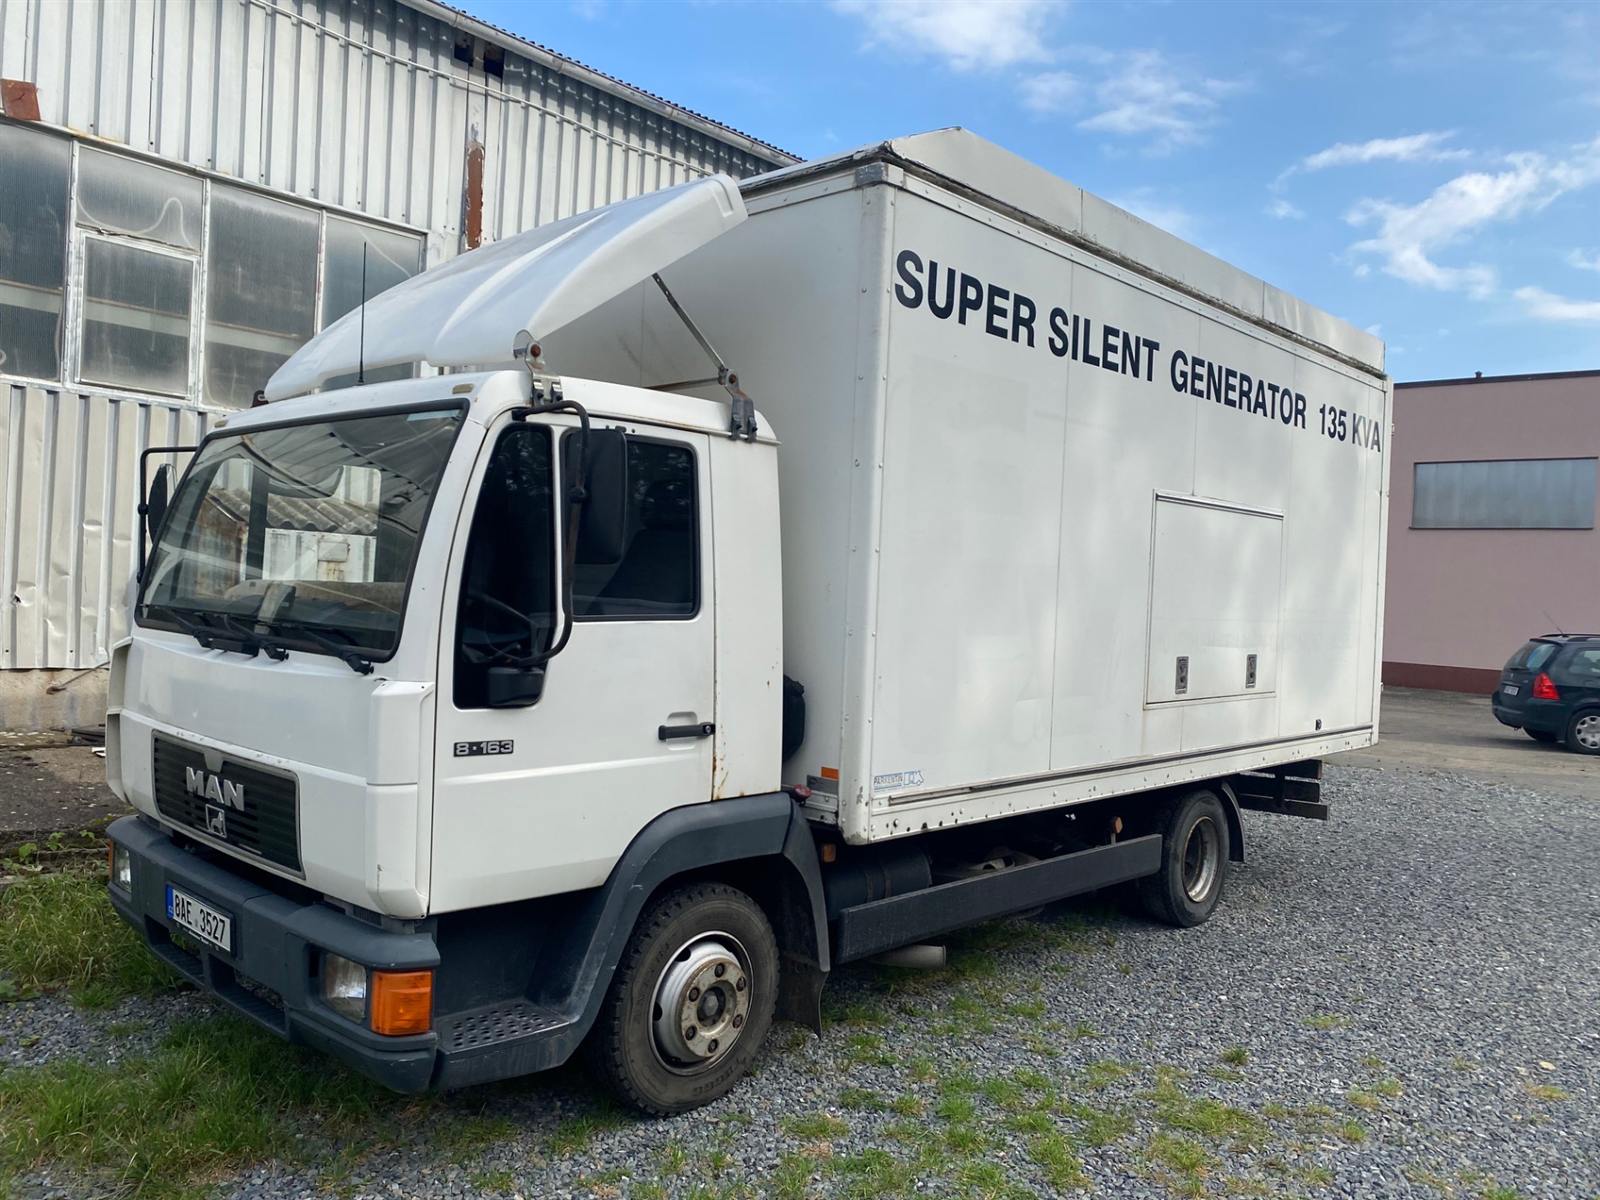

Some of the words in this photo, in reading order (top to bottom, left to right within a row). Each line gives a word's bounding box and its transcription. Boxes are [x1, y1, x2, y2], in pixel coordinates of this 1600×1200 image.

[895, 249, 1036, 348] SUPER
[1048, 307, 1160, 382] SILENT
[1171, 349, 1307, 430] GENERATOR
[1319, 403, 1347, 442] 135
[1352, 412, 1382, 453] KVA
[186, 766, 245, 811] MAN
[200, 908, 225, 942] 3527
